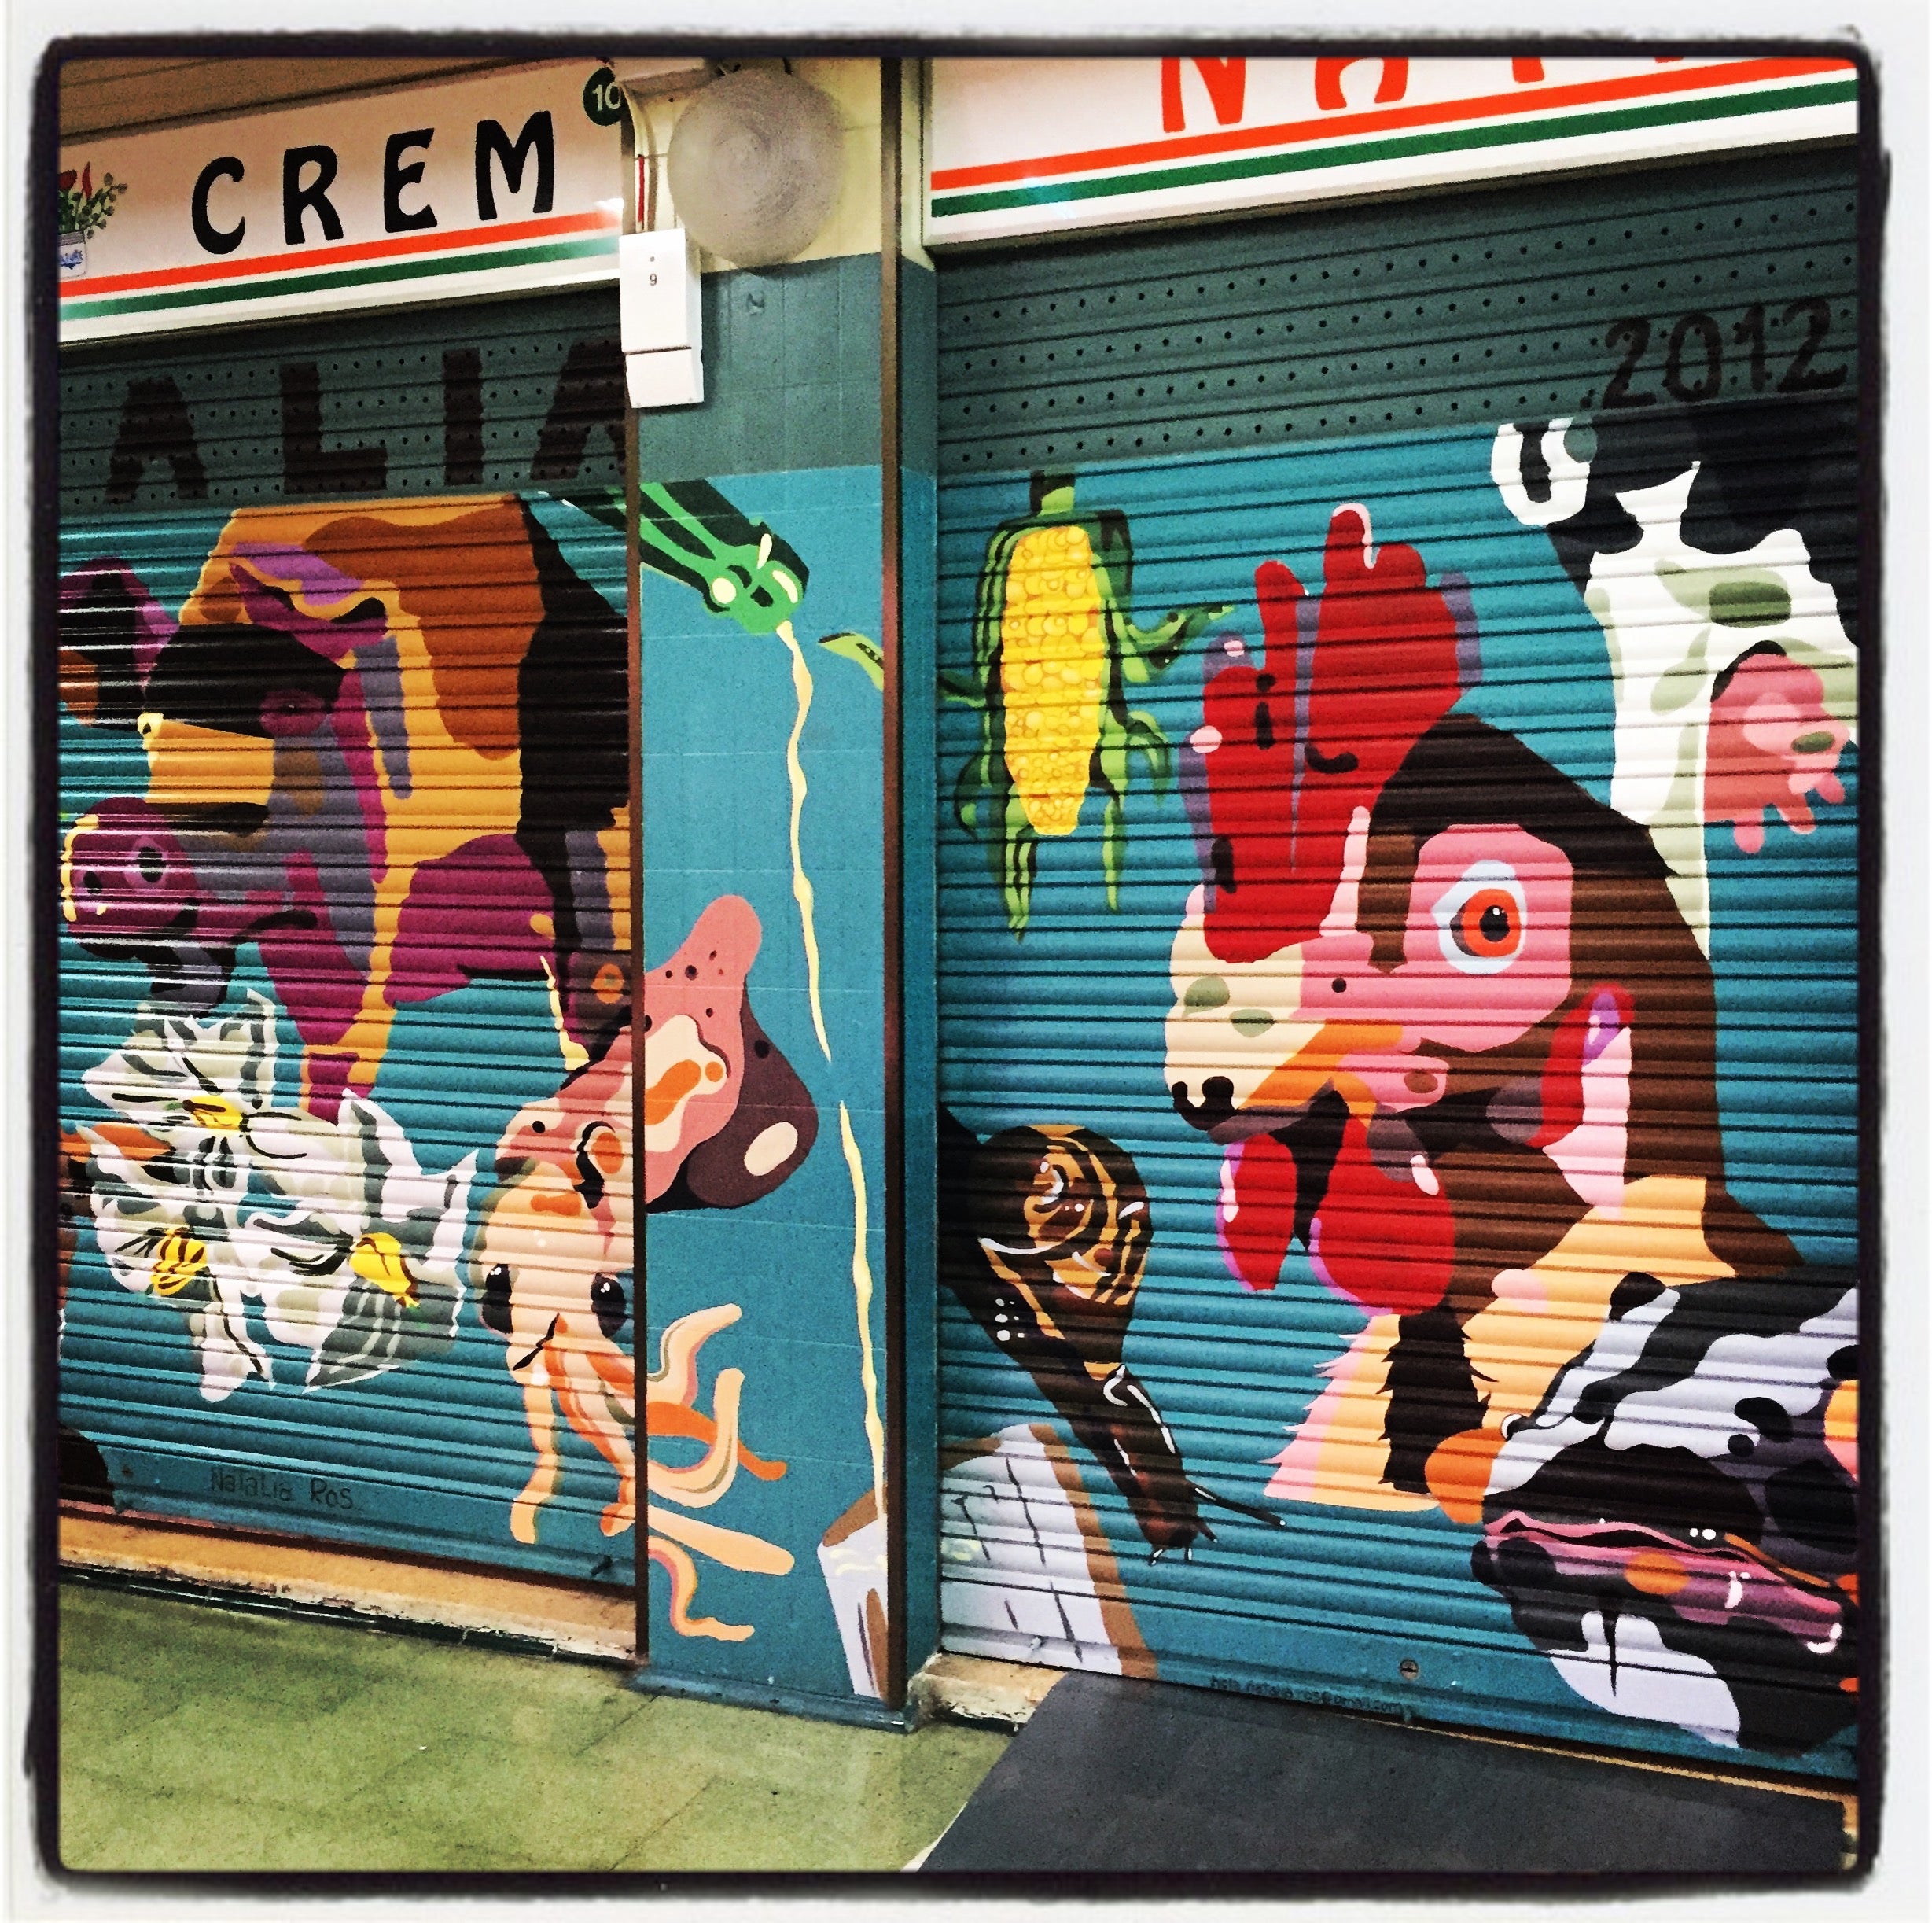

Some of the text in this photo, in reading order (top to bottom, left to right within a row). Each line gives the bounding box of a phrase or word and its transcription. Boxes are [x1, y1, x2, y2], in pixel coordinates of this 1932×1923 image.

[592, 82, 622, 112] 10
[192, 110, 557, 255] CREM
[650, 273, 657, 286] 9
[104, 338, 627, 505] ALIA
